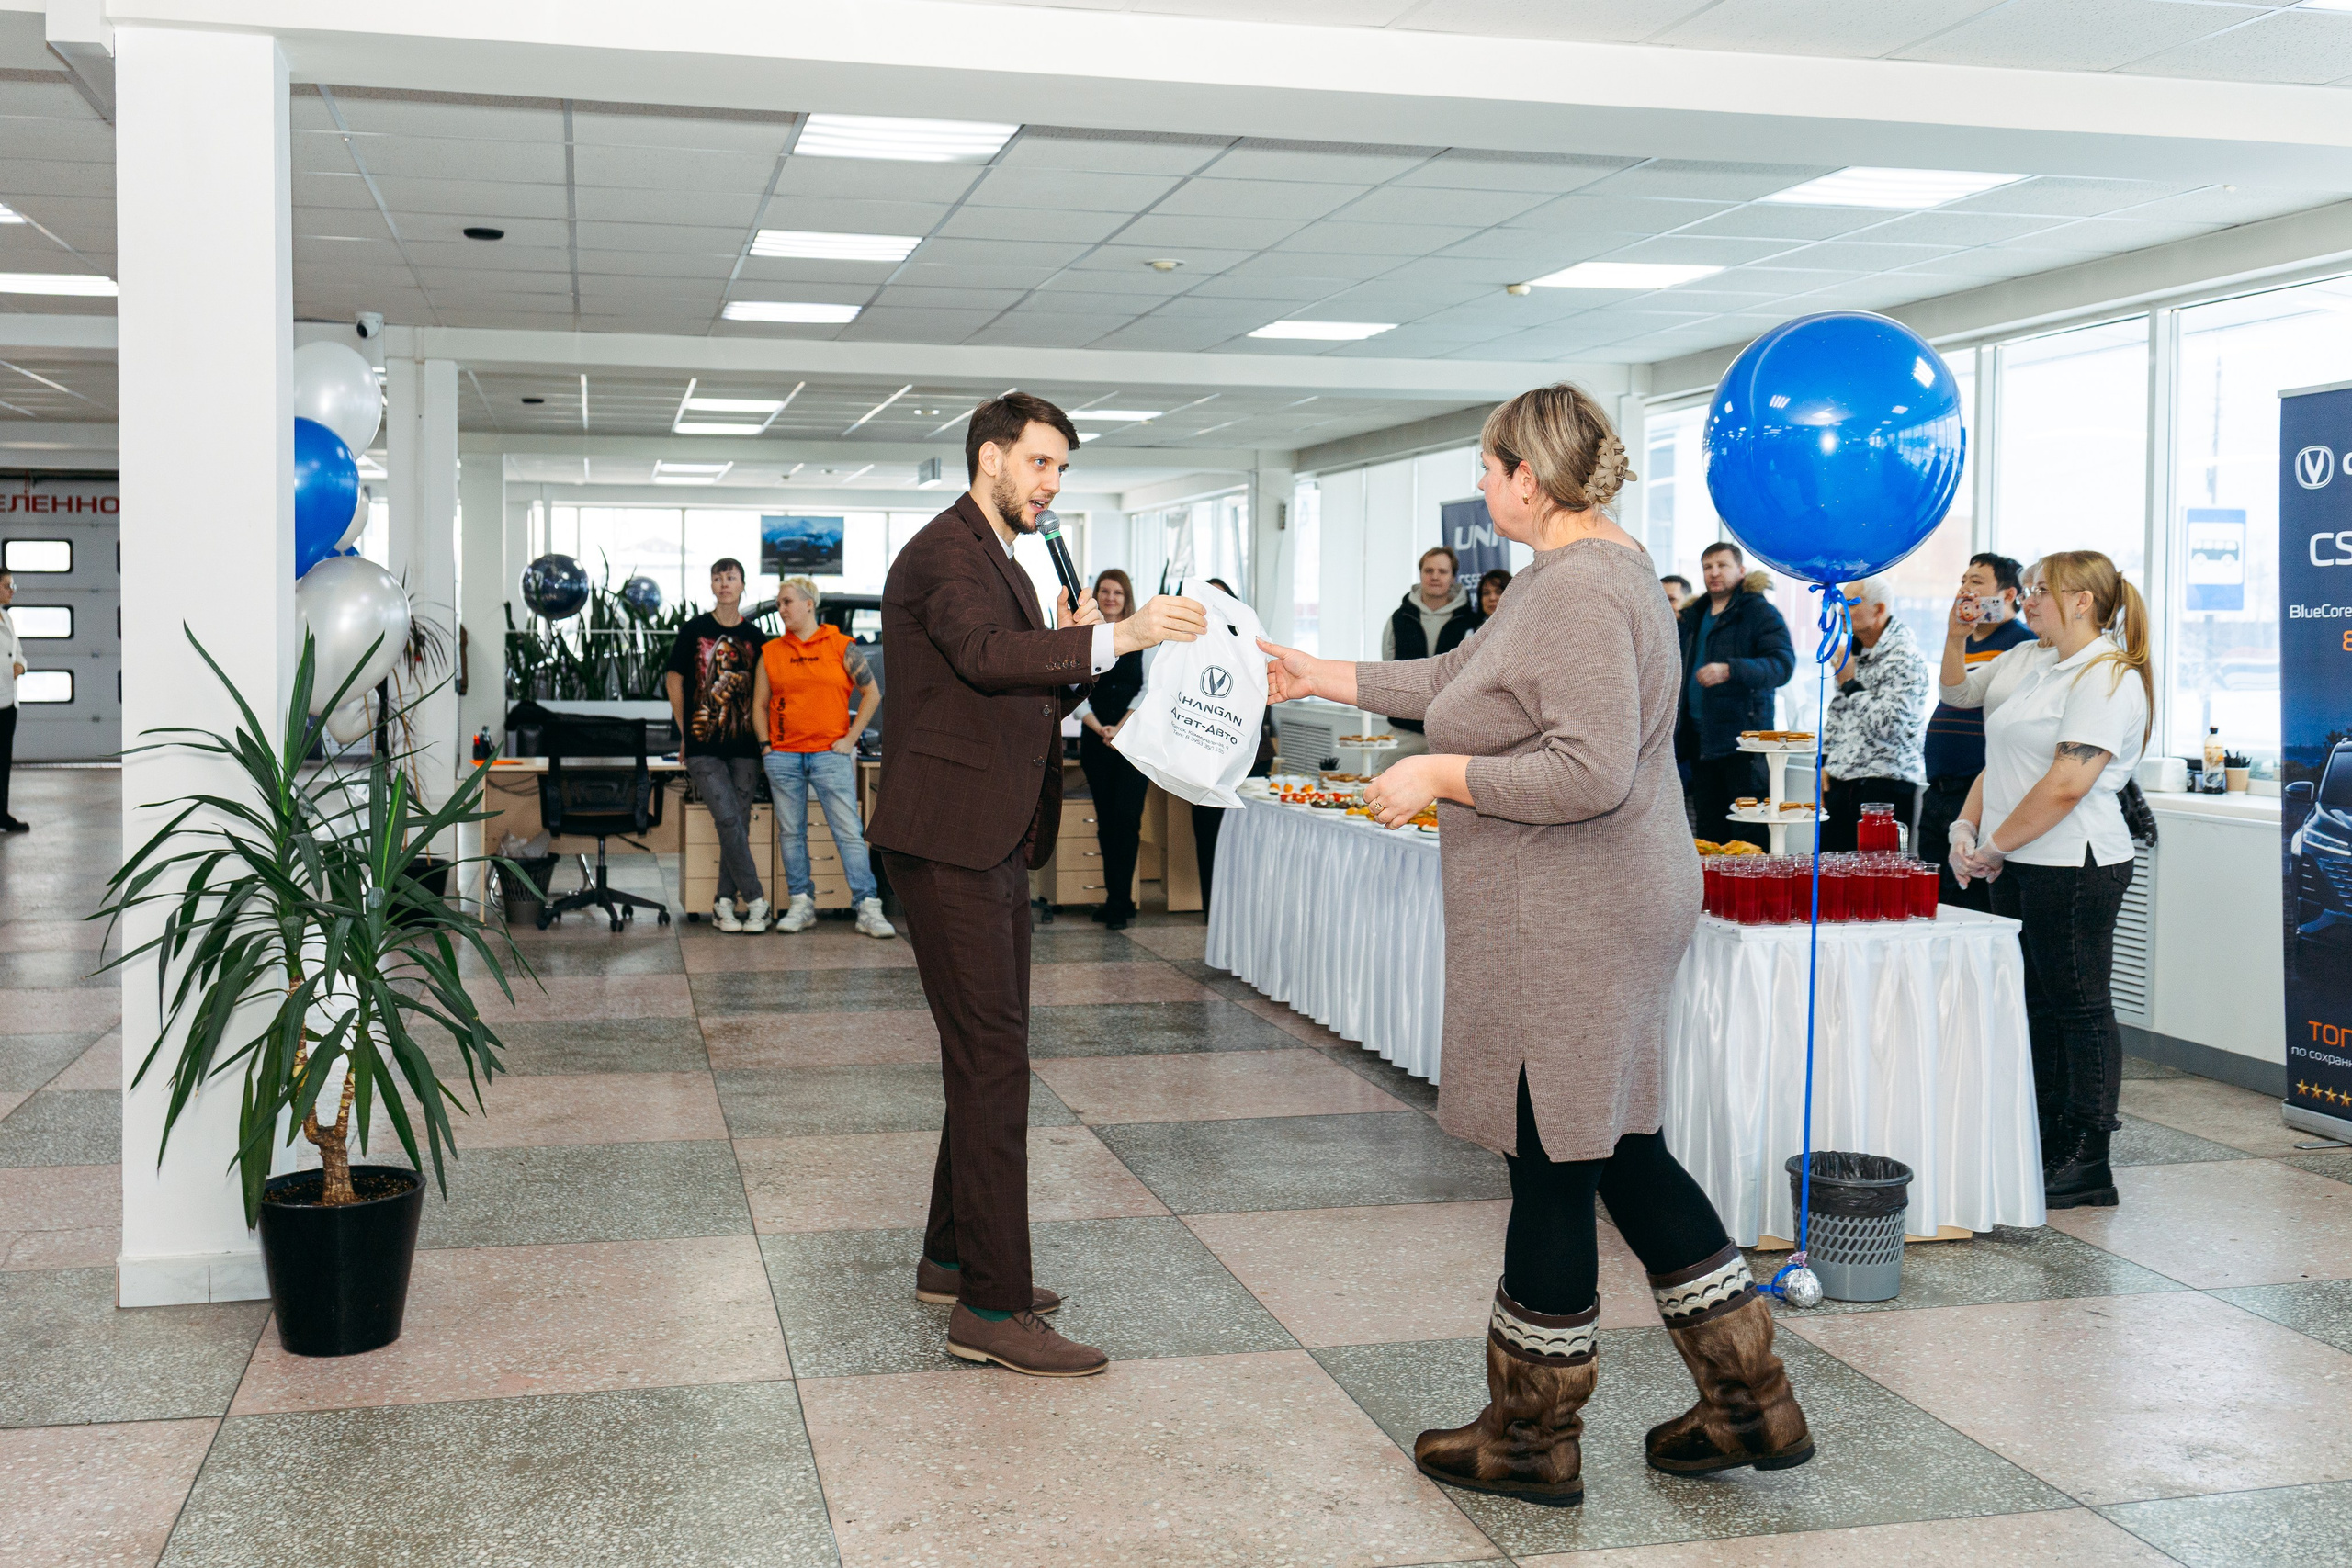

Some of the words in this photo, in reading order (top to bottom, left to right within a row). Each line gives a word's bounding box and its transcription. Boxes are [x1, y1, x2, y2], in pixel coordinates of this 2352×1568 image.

[2289, 604, 2352, 618] BlueCore
[1170, 706, 1238, 745] Агат-Авто
[2290, 1046, 2307, 1057] по
